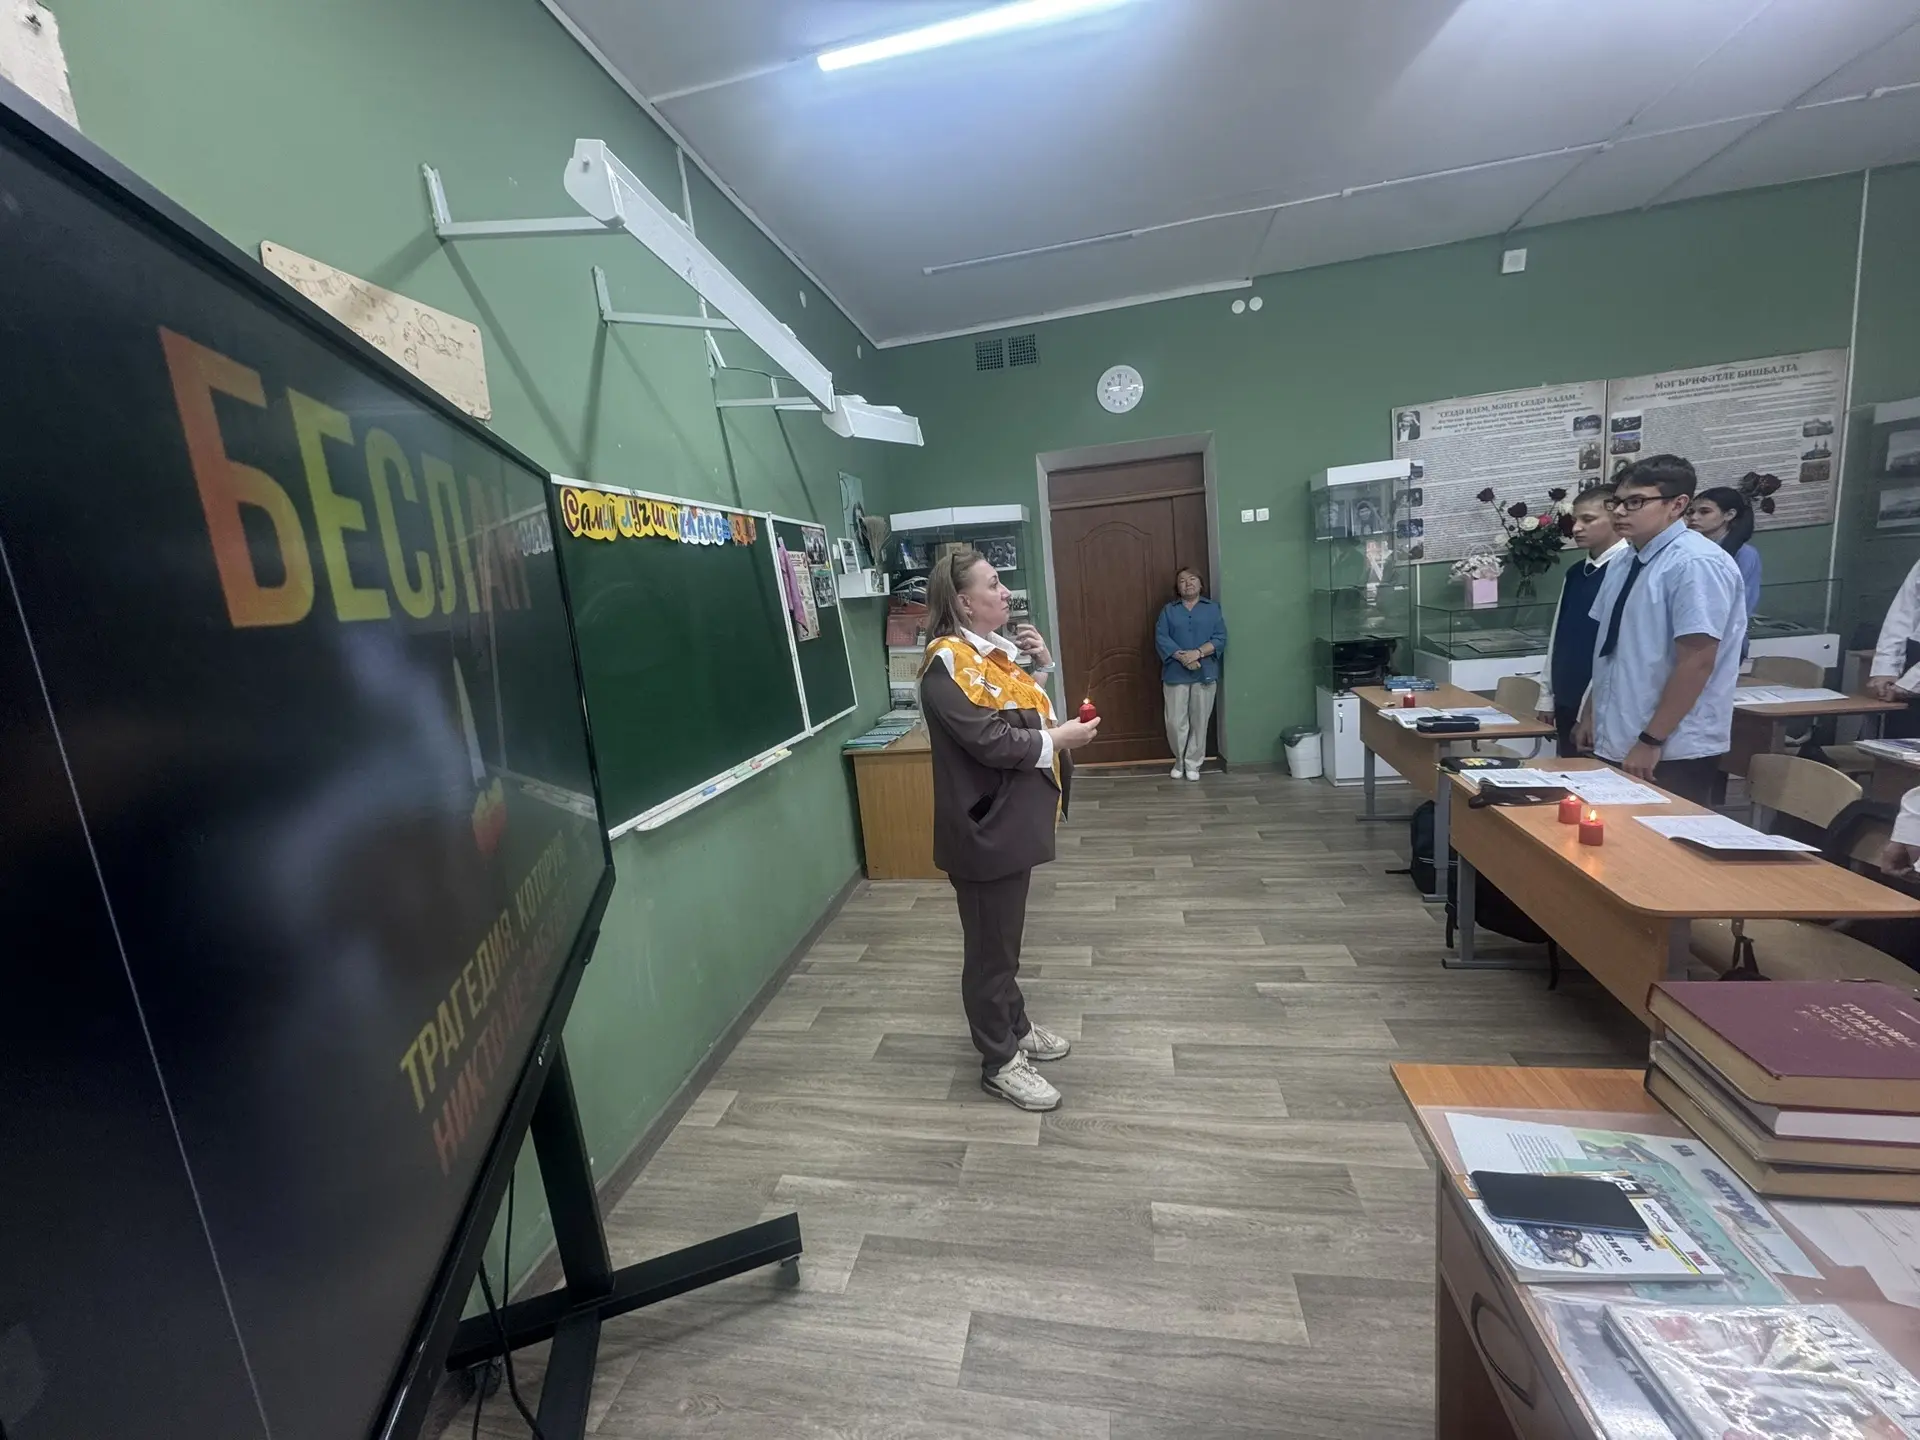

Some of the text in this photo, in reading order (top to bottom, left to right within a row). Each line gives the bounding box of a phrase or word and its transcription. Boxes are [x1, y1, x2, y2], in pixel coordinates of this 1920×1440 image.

[157, 326, 532, 629] БЕСЛАН
[432, 1010, 504, 1178] НИКТО
[1841, 1002, 1920, 1048] ТОЛКОВЫ
